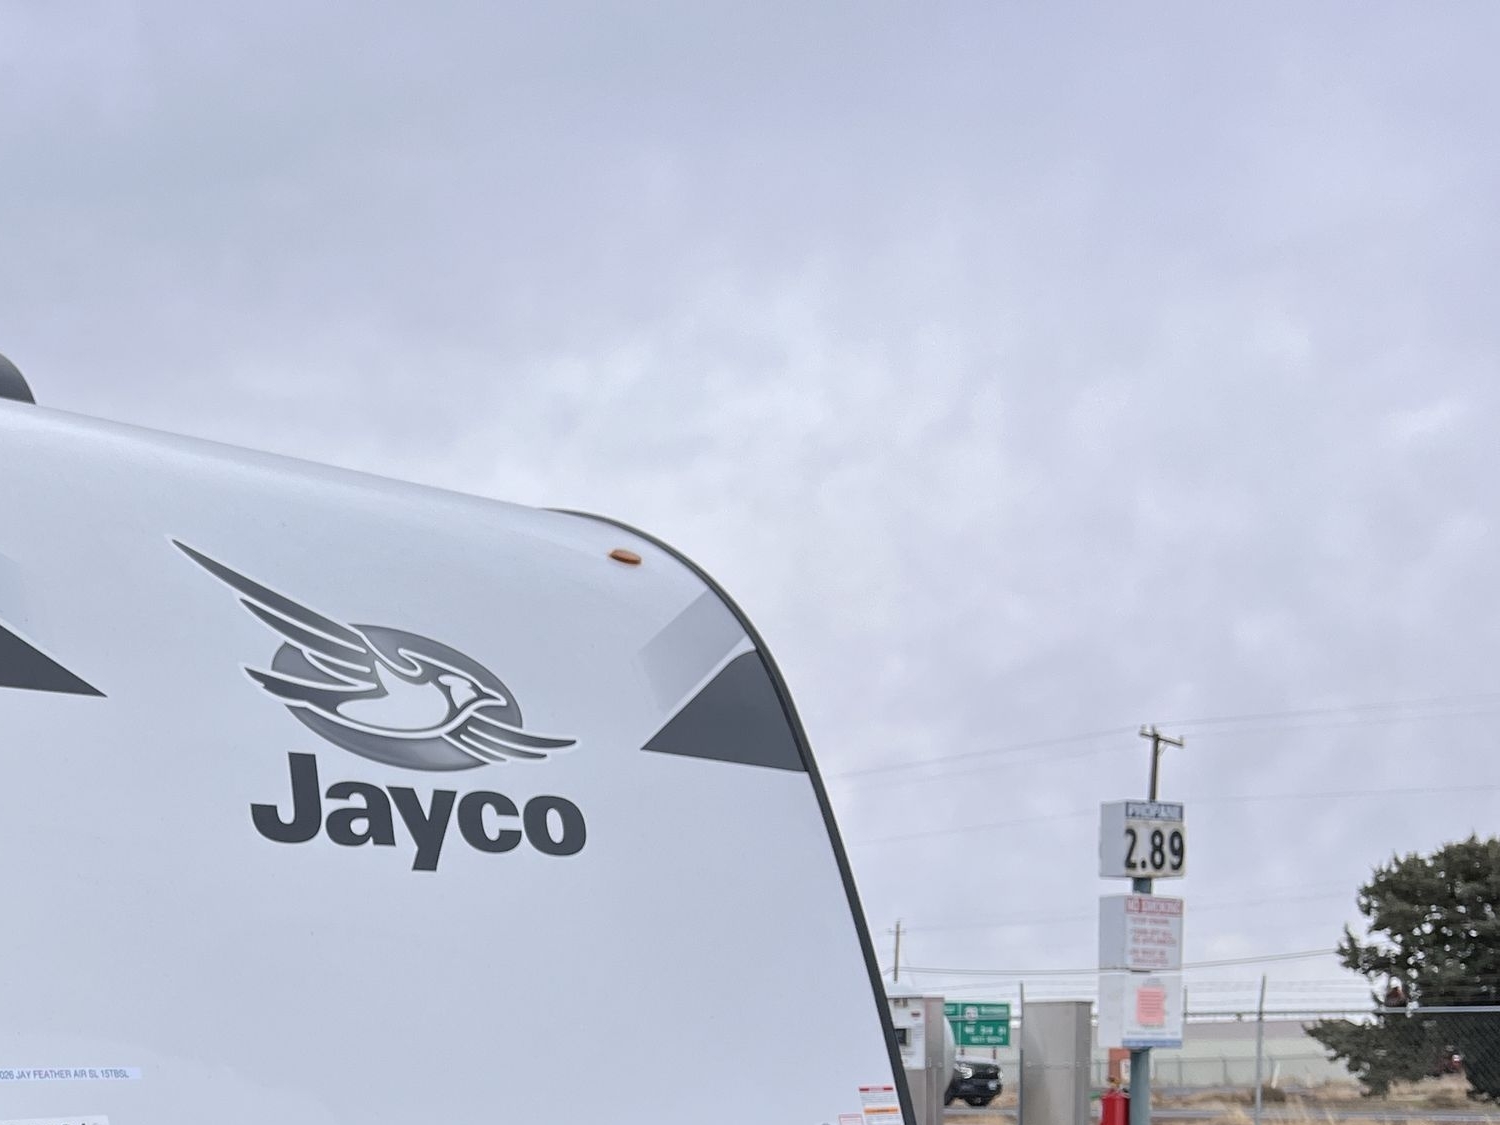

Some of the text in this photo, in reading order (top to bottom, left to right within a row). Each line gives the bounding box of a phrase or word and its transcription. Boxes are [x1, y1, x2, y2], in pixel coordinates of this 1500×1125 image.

[250, 752, 587, 872] Jayco
[1124, 828, 1184, 871] 2.89
[16, 1070, 31, 1079] JAY
[33, 1069, 71, 1079] FEATHER
[73, 1069, 87, 1078] AIR
[100, 1069, 129, 1078] 15TBSL
